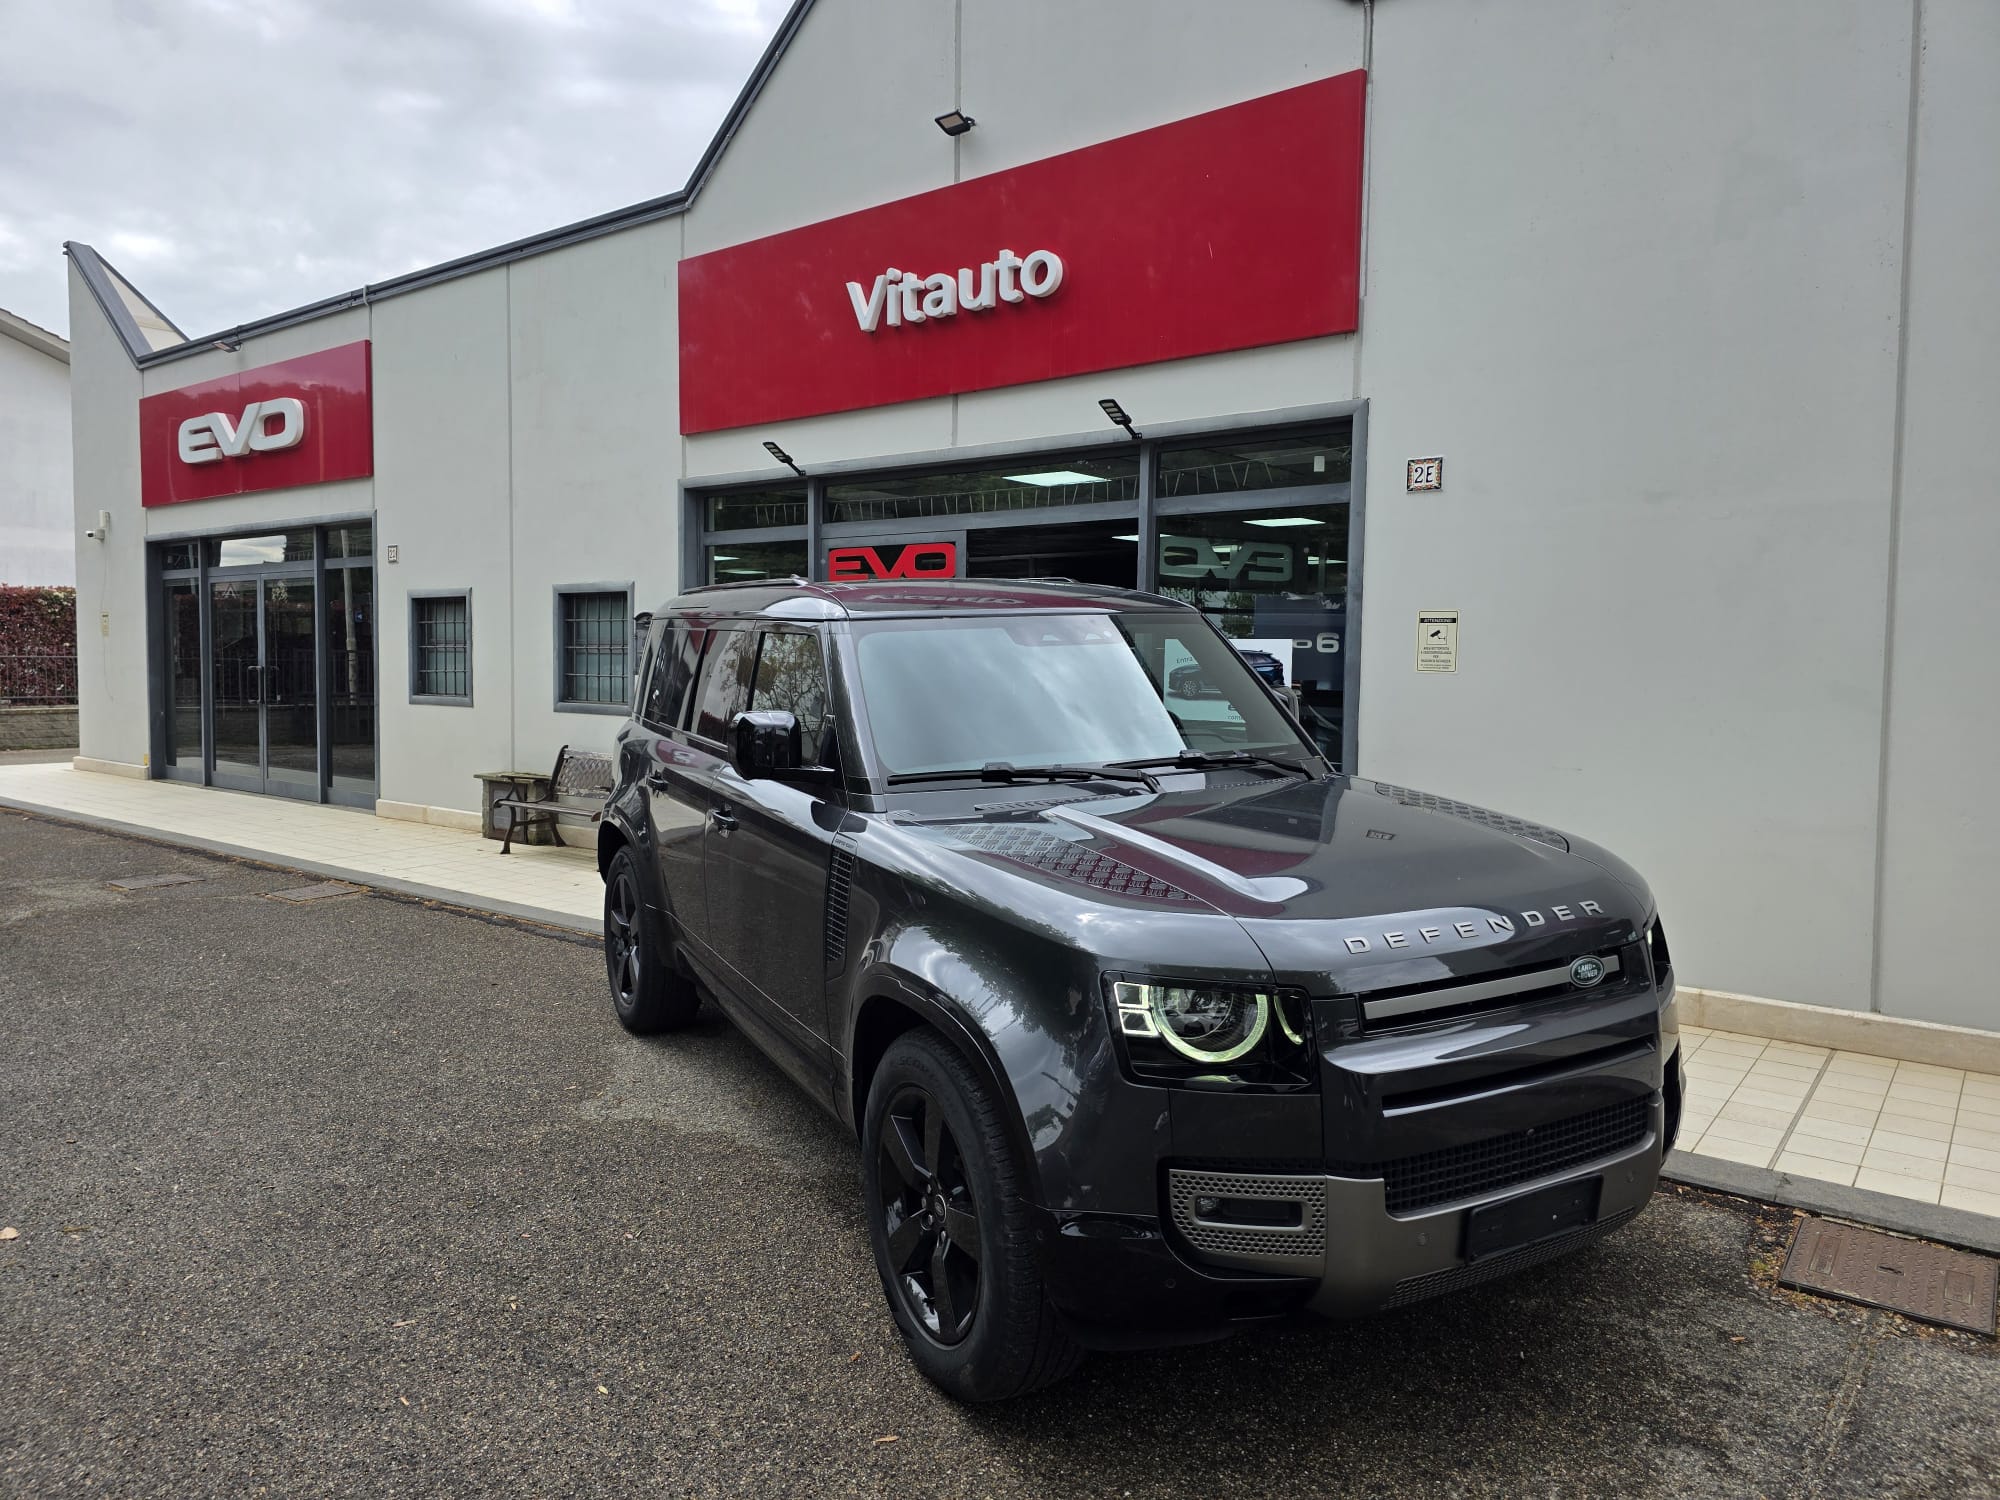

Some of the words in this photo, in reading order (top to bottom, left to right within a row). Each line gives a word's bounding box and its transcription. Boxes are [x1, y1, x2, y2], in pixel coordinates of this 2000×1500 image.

[846, 249, 1063, 332] Vitauto
[178, 397, 304, 464] EVO
[1414, 465, 1435, 484] 2E
[828, 542, 956, 582] EVO
[1343, 900, 1604, 955] DEFENDER
